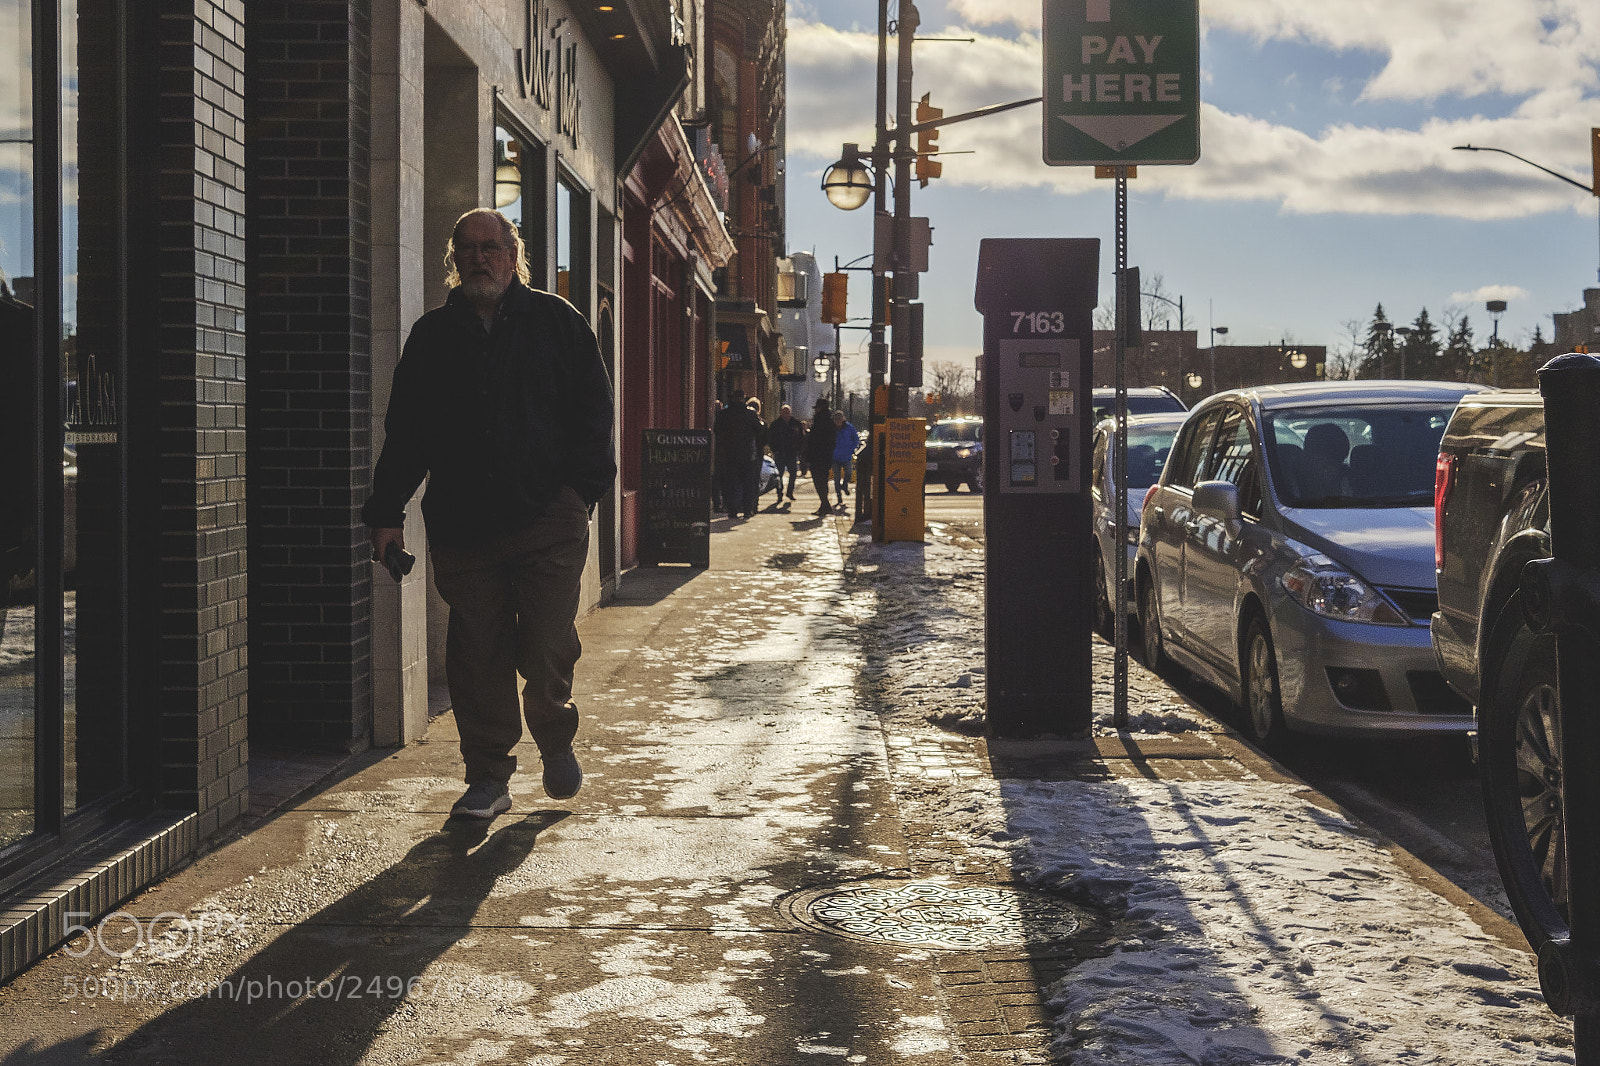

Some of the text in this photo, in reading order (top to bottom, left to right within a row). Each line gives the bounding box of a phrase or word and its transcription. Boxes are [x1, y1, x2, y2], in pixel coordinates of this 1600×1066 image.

[1082, 35, 1163, 64] PAY
[1062, 73, 1181, 102] HERE
[1010, 311, 1065, 333] 7163
[657, 434, 708, 445] GUINNESS
